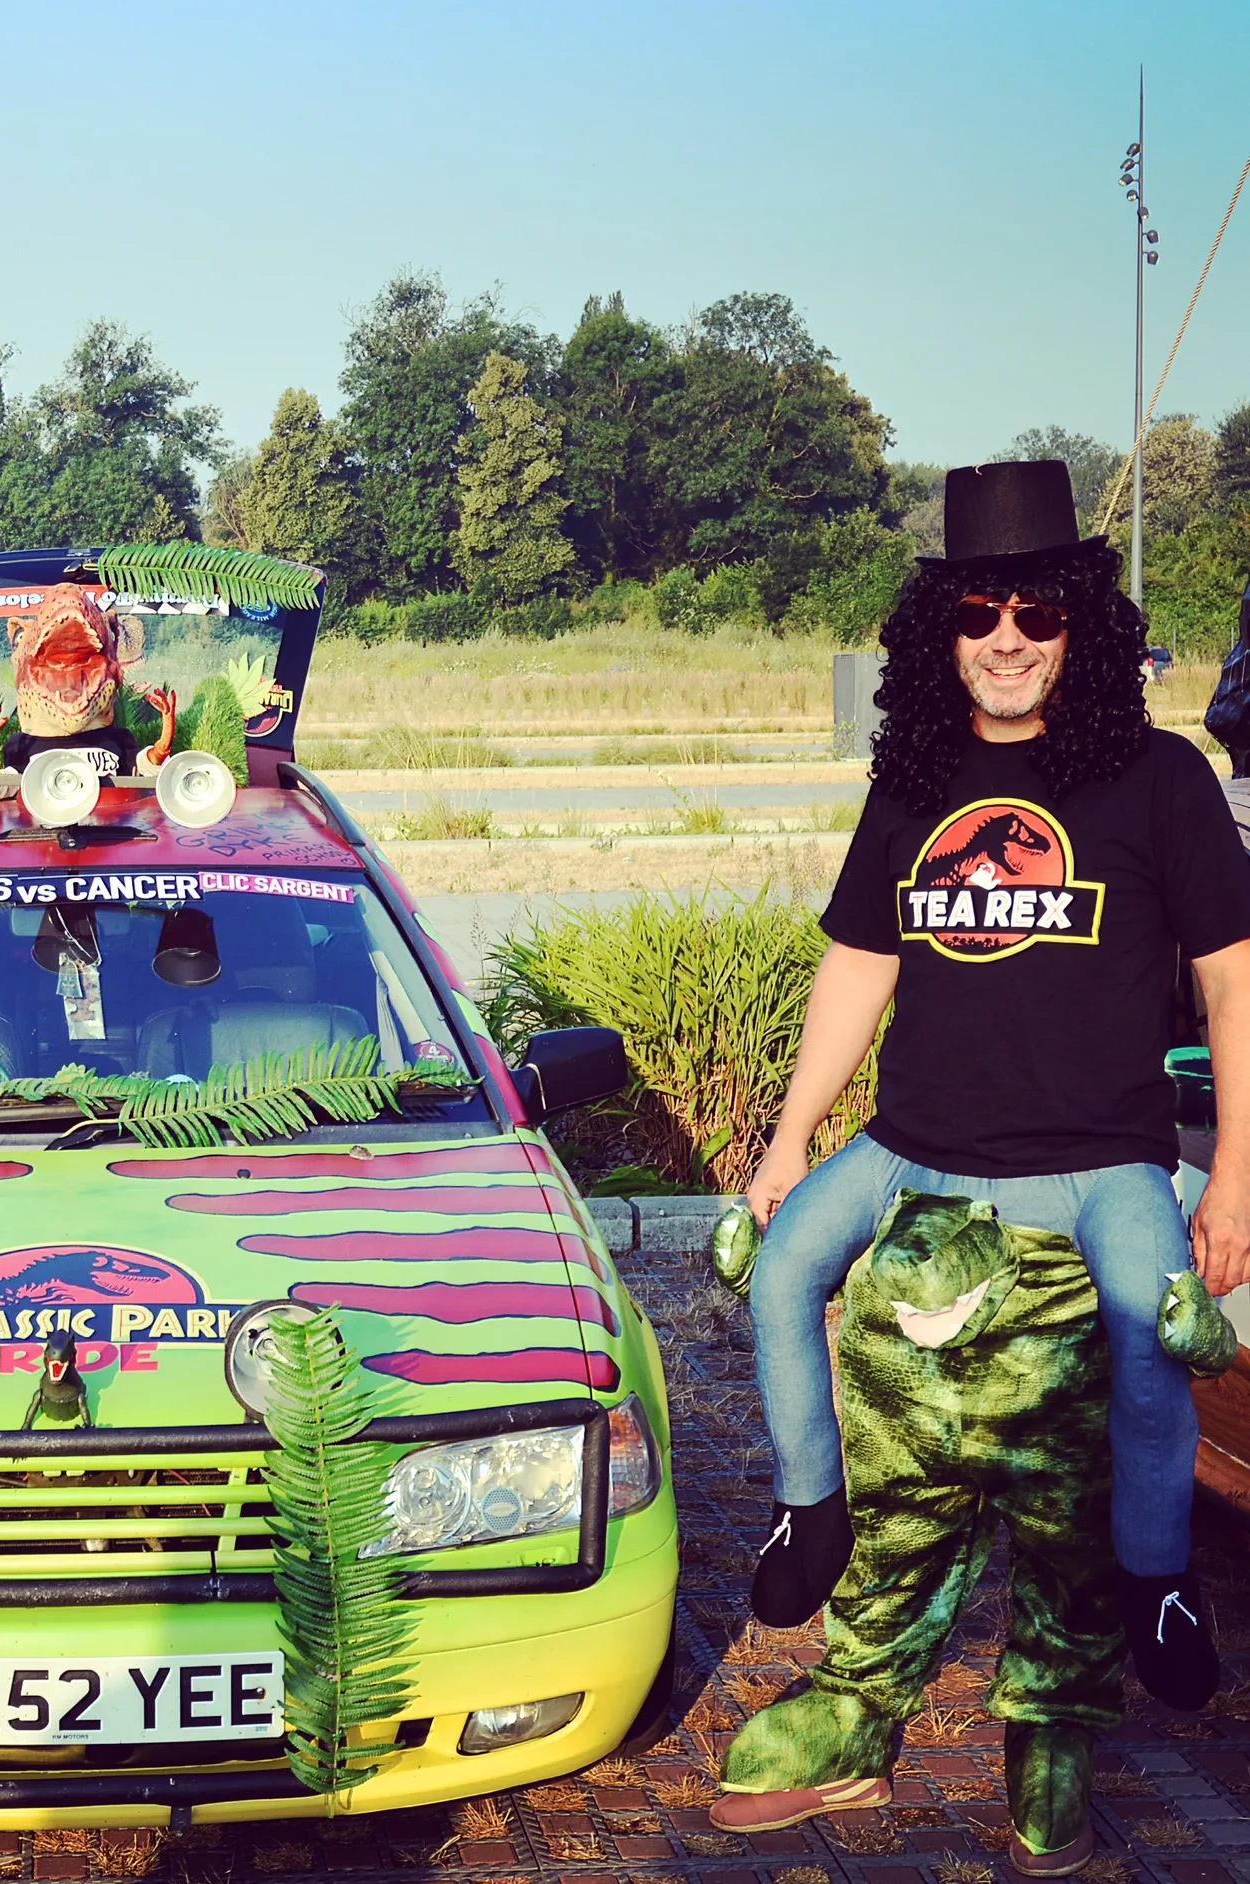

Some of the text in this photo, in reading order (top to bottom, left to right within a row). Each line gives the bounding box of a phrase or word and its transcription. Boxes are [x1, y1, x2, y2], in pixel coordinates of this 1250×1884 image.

[262, 841, 338, 861] PRIMARY
[16, 884, 57, 904] vs
[65, 875, 201, 901] CANCER
[202, 873, 351, 902] CLIC SARGENT
[908, 890, 1074, 930] TEA REX
[128, 1662, 274, 1730] YEE
